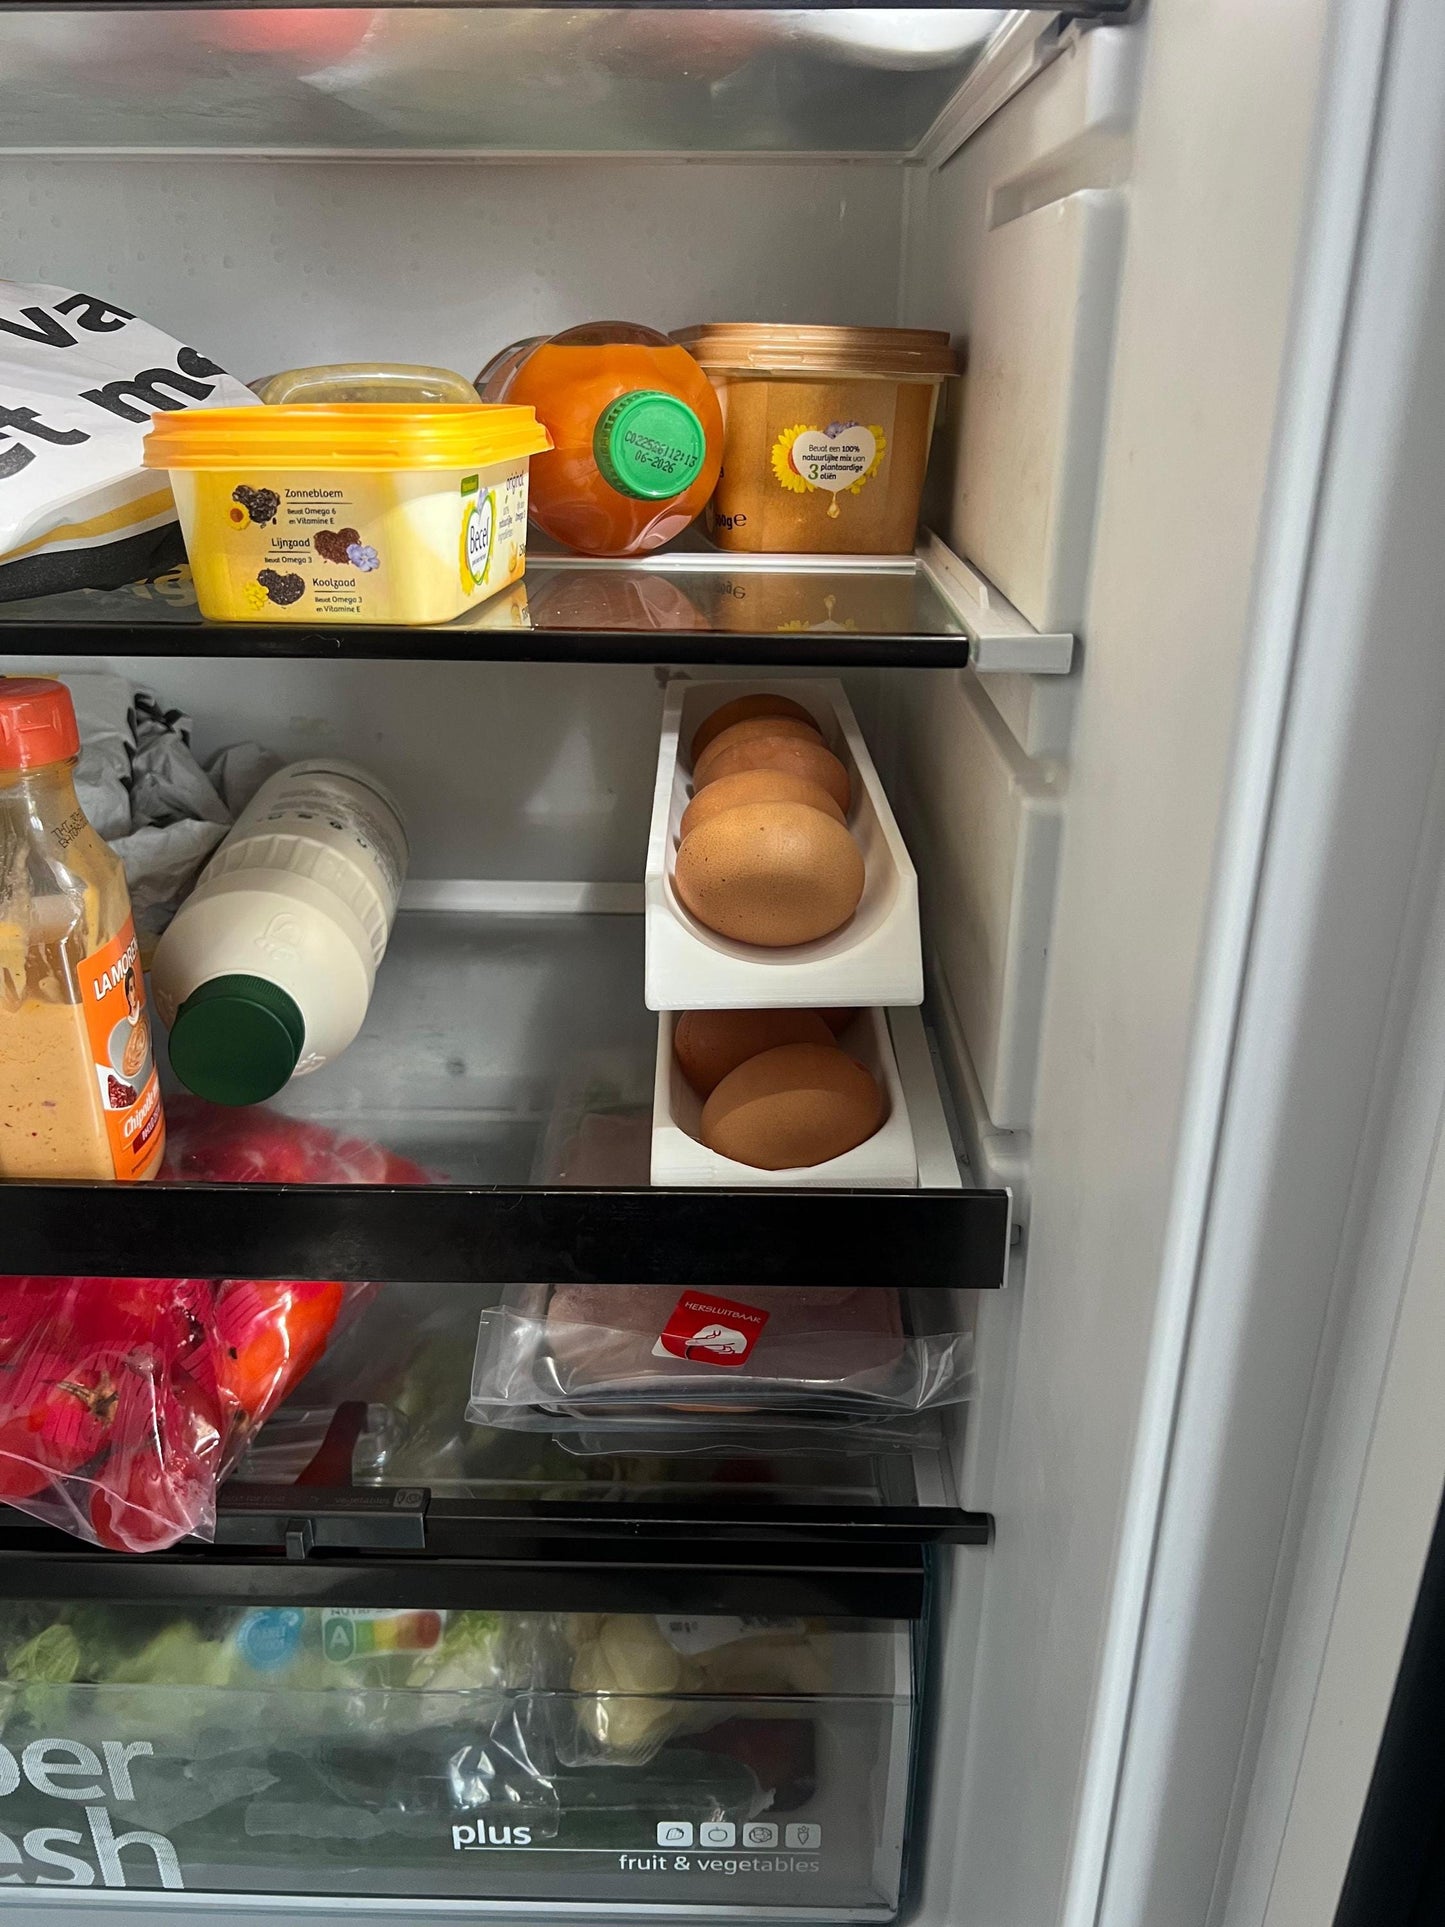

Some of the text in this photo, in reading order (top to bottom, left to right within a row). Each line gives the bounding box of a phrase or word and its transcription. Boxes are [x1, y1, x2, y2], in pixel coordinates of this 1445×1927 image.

[808, 444, 828, 453] Bevat
[842, 445, 861, 453] 100%
[634, 449, 677, 474] 06-2026
[802, 454, 839, 463] natuurlijke
[839, 454, 852, 462] mix
[808, 463, 864, 480] 3 plantaardige
[820, 472, 837, 480] oliën
[284, 488, 344, 498] Zonnebloem
[304, 507, 331, 517] Omega
[296, 517, 329, 525] Vitamine
[470, 516, 490, 554] Becel
[271, 537, 311, 550] Lijnzaad
[281, 556, 307, 565] Omega
[312, 577, 356, 590] Koolzaad
[331, 595, 357, 605] Omega
[323, 605, 356, 613] Vitamine
[93, 972, 113, 1001] LA
[330, 1625, 350, 1649] A
[451, 1819, 532, 1850] plus
[618, 1854, 821, 1876] fruit & vegetables
